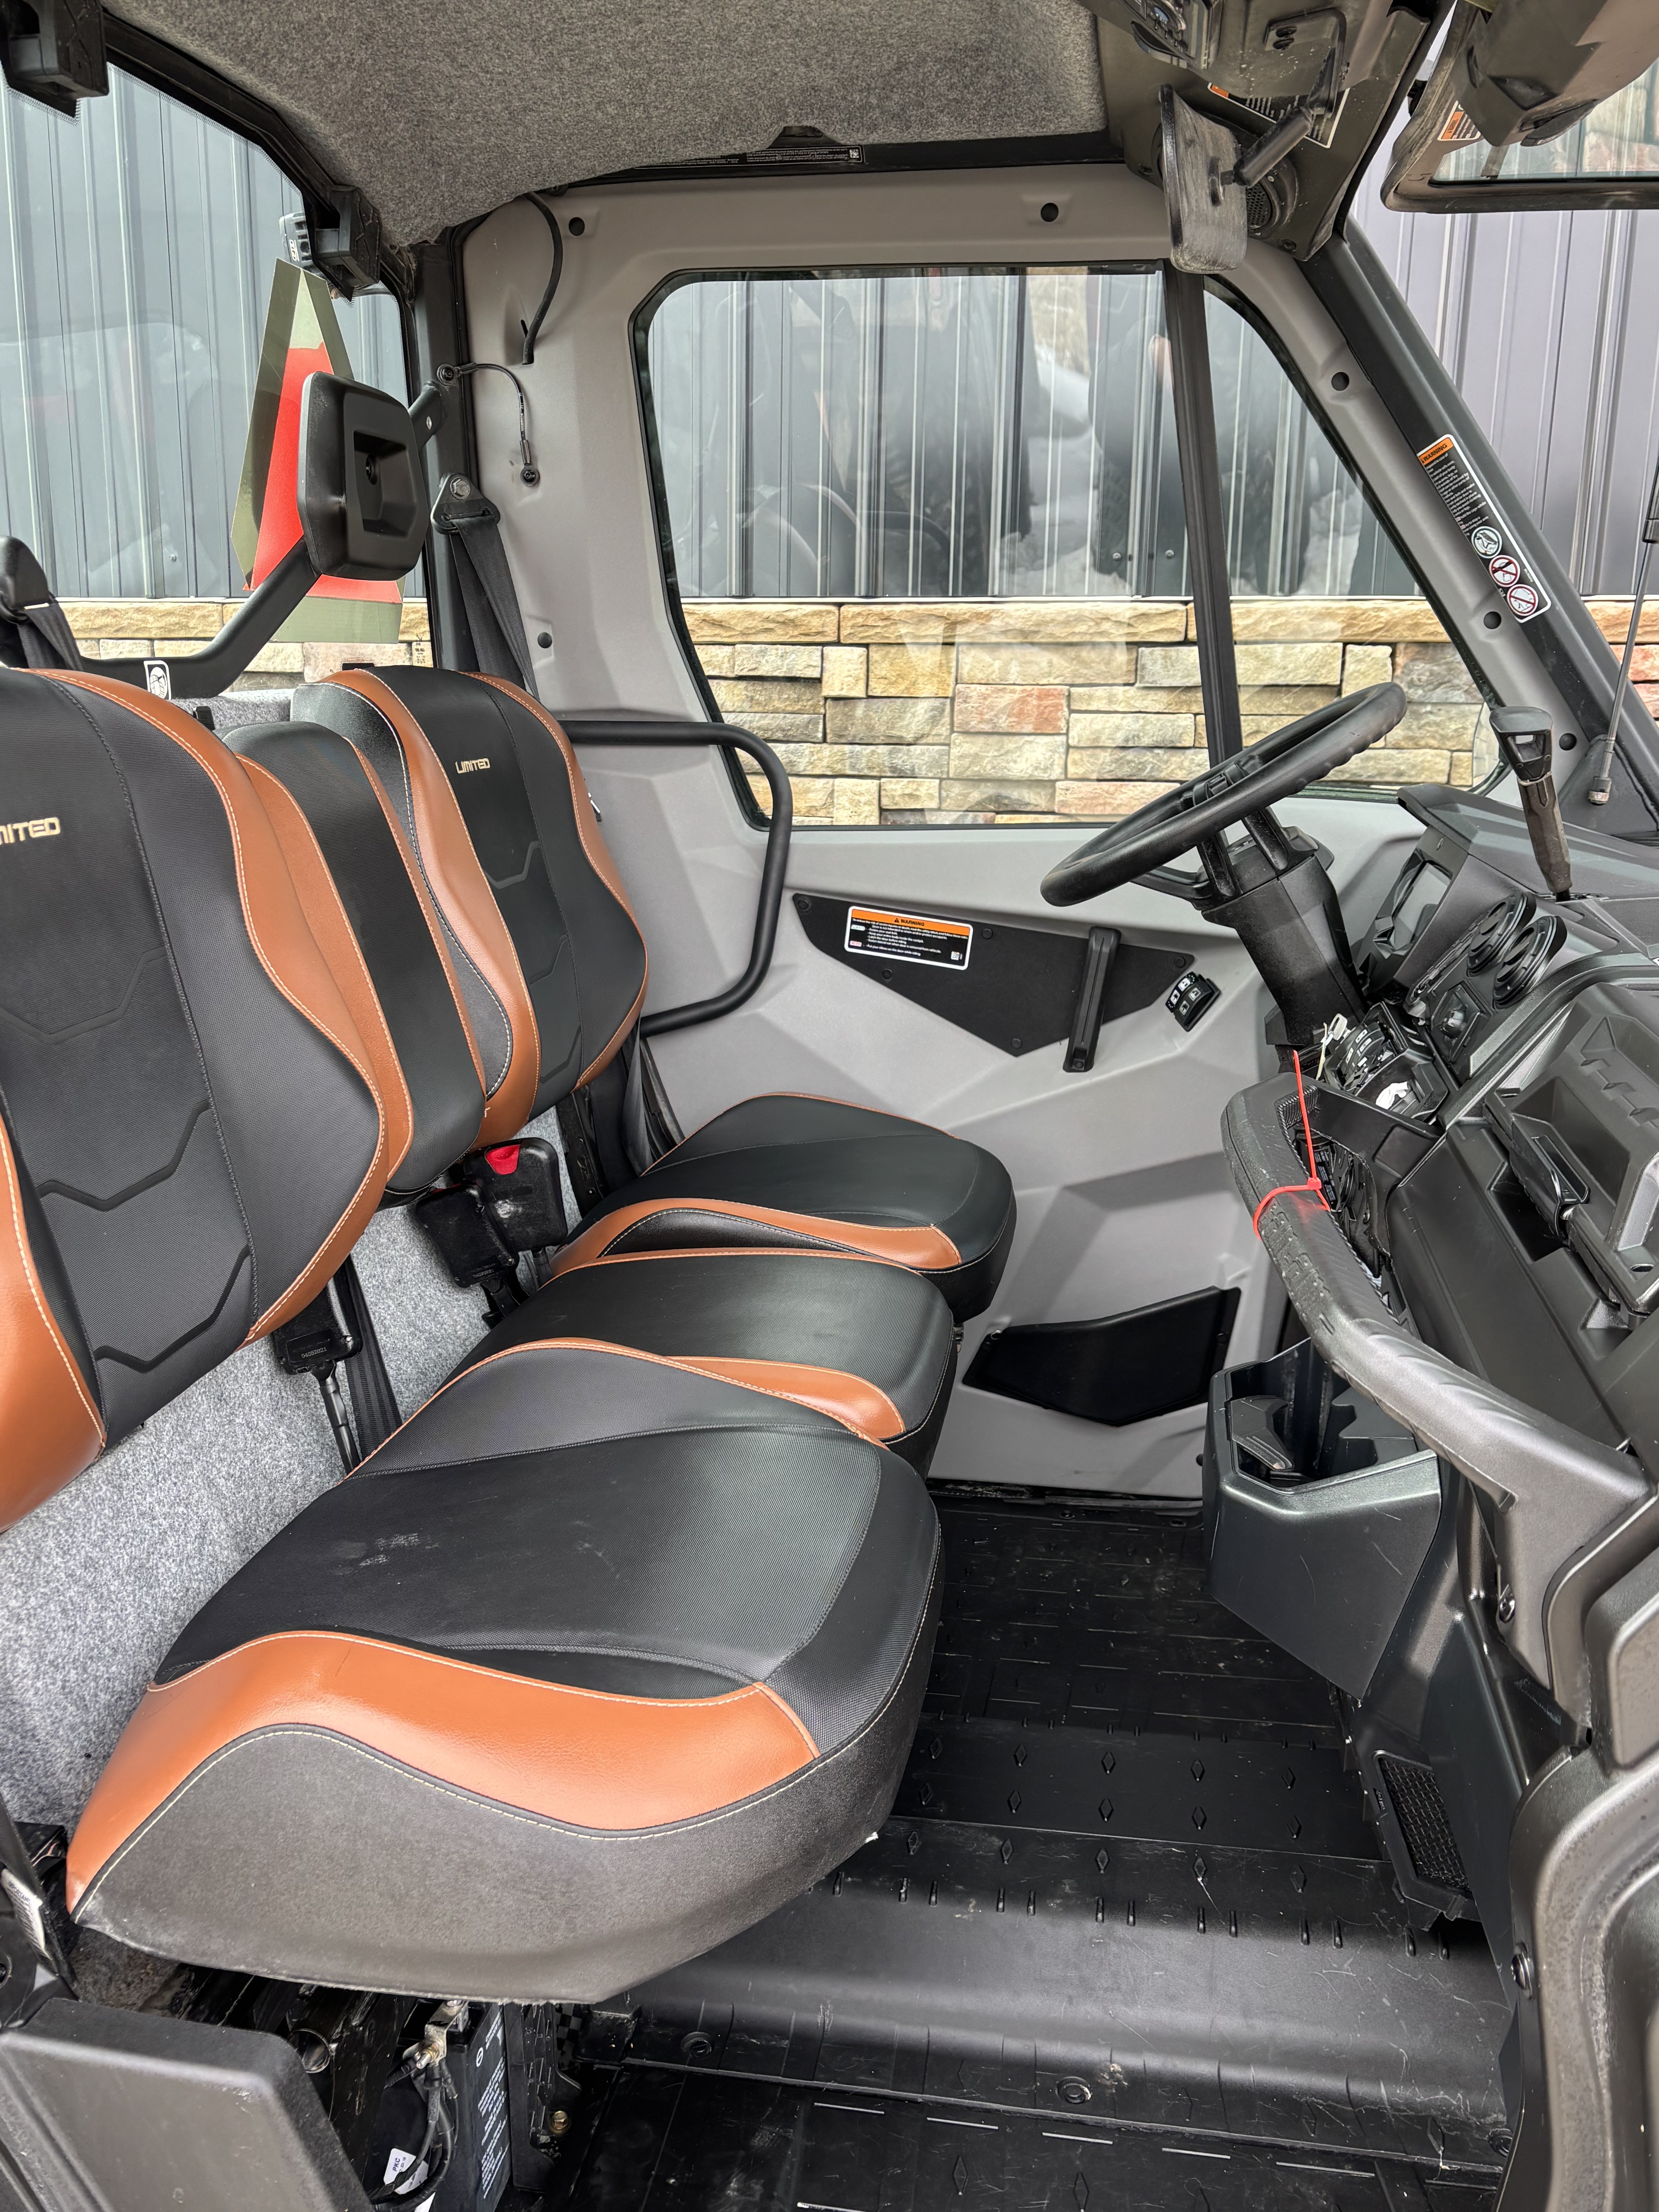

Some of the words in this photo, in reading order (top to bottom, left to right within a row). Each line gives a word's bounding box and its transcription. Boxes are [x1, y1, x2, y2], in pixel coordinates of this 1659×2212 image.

[1423, 443, 1448, 461] WARNING
[455, 758, 490, 774] LIMITED
[0, 817, 61, 845] MITED
[901, 918, 924, 926] WARNING
